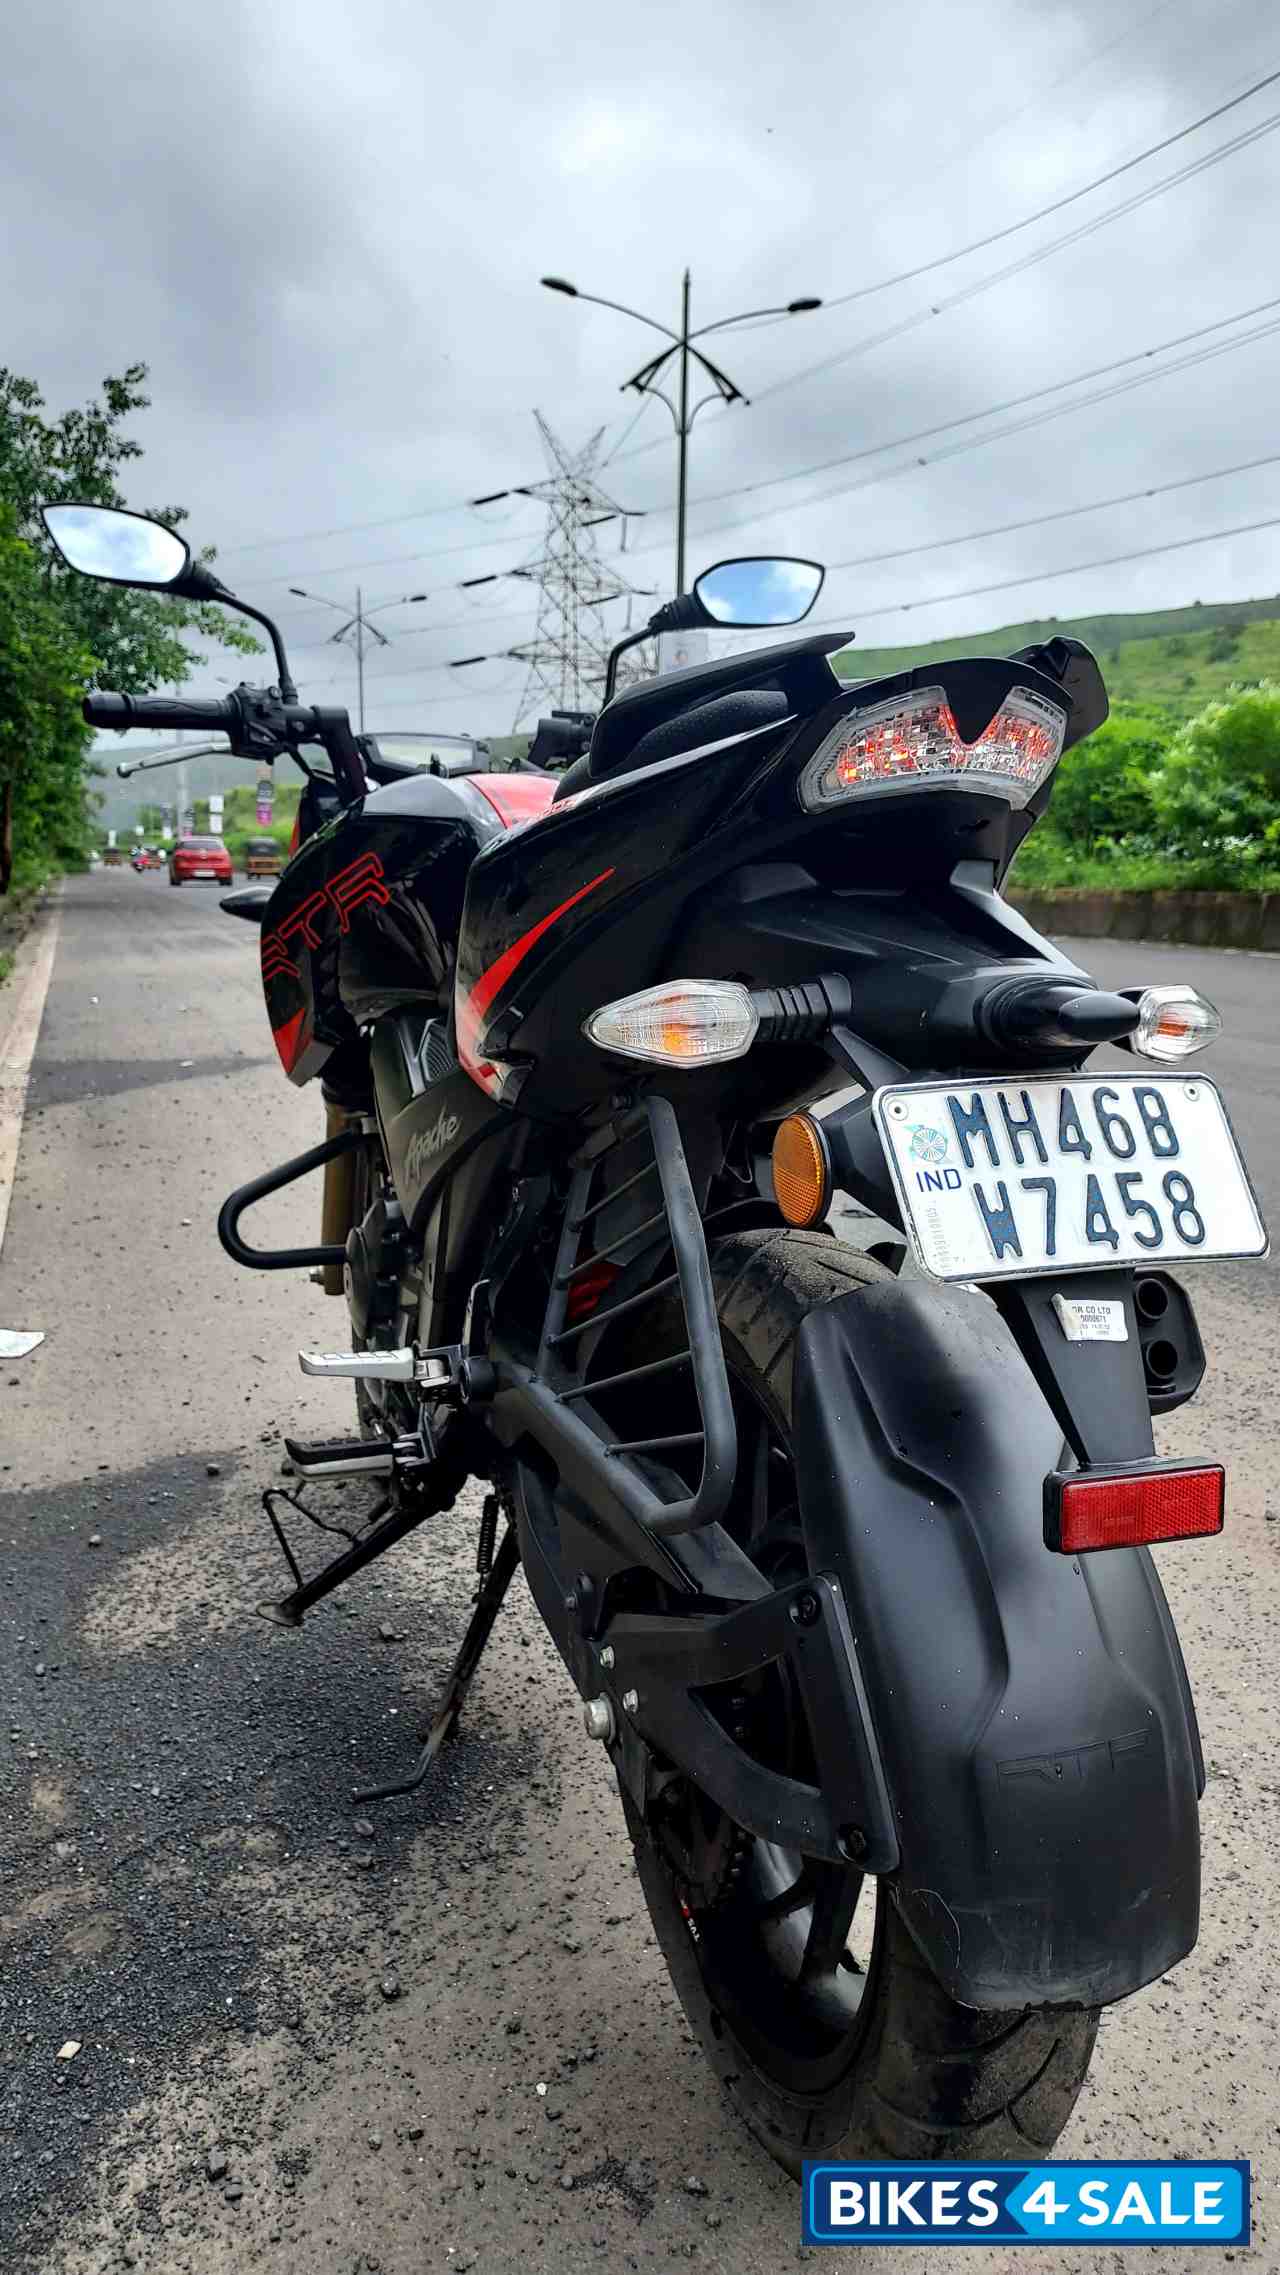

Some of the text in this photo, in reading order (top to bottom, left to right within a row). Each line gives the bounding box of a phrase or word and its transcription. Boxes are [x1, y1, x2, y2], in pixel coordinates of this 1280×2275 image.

[946, 1086, 1180, 1168] MH46B
[916, 1168, 962, 1193] IND
[973, 1170, 1206, 1259] W7458
